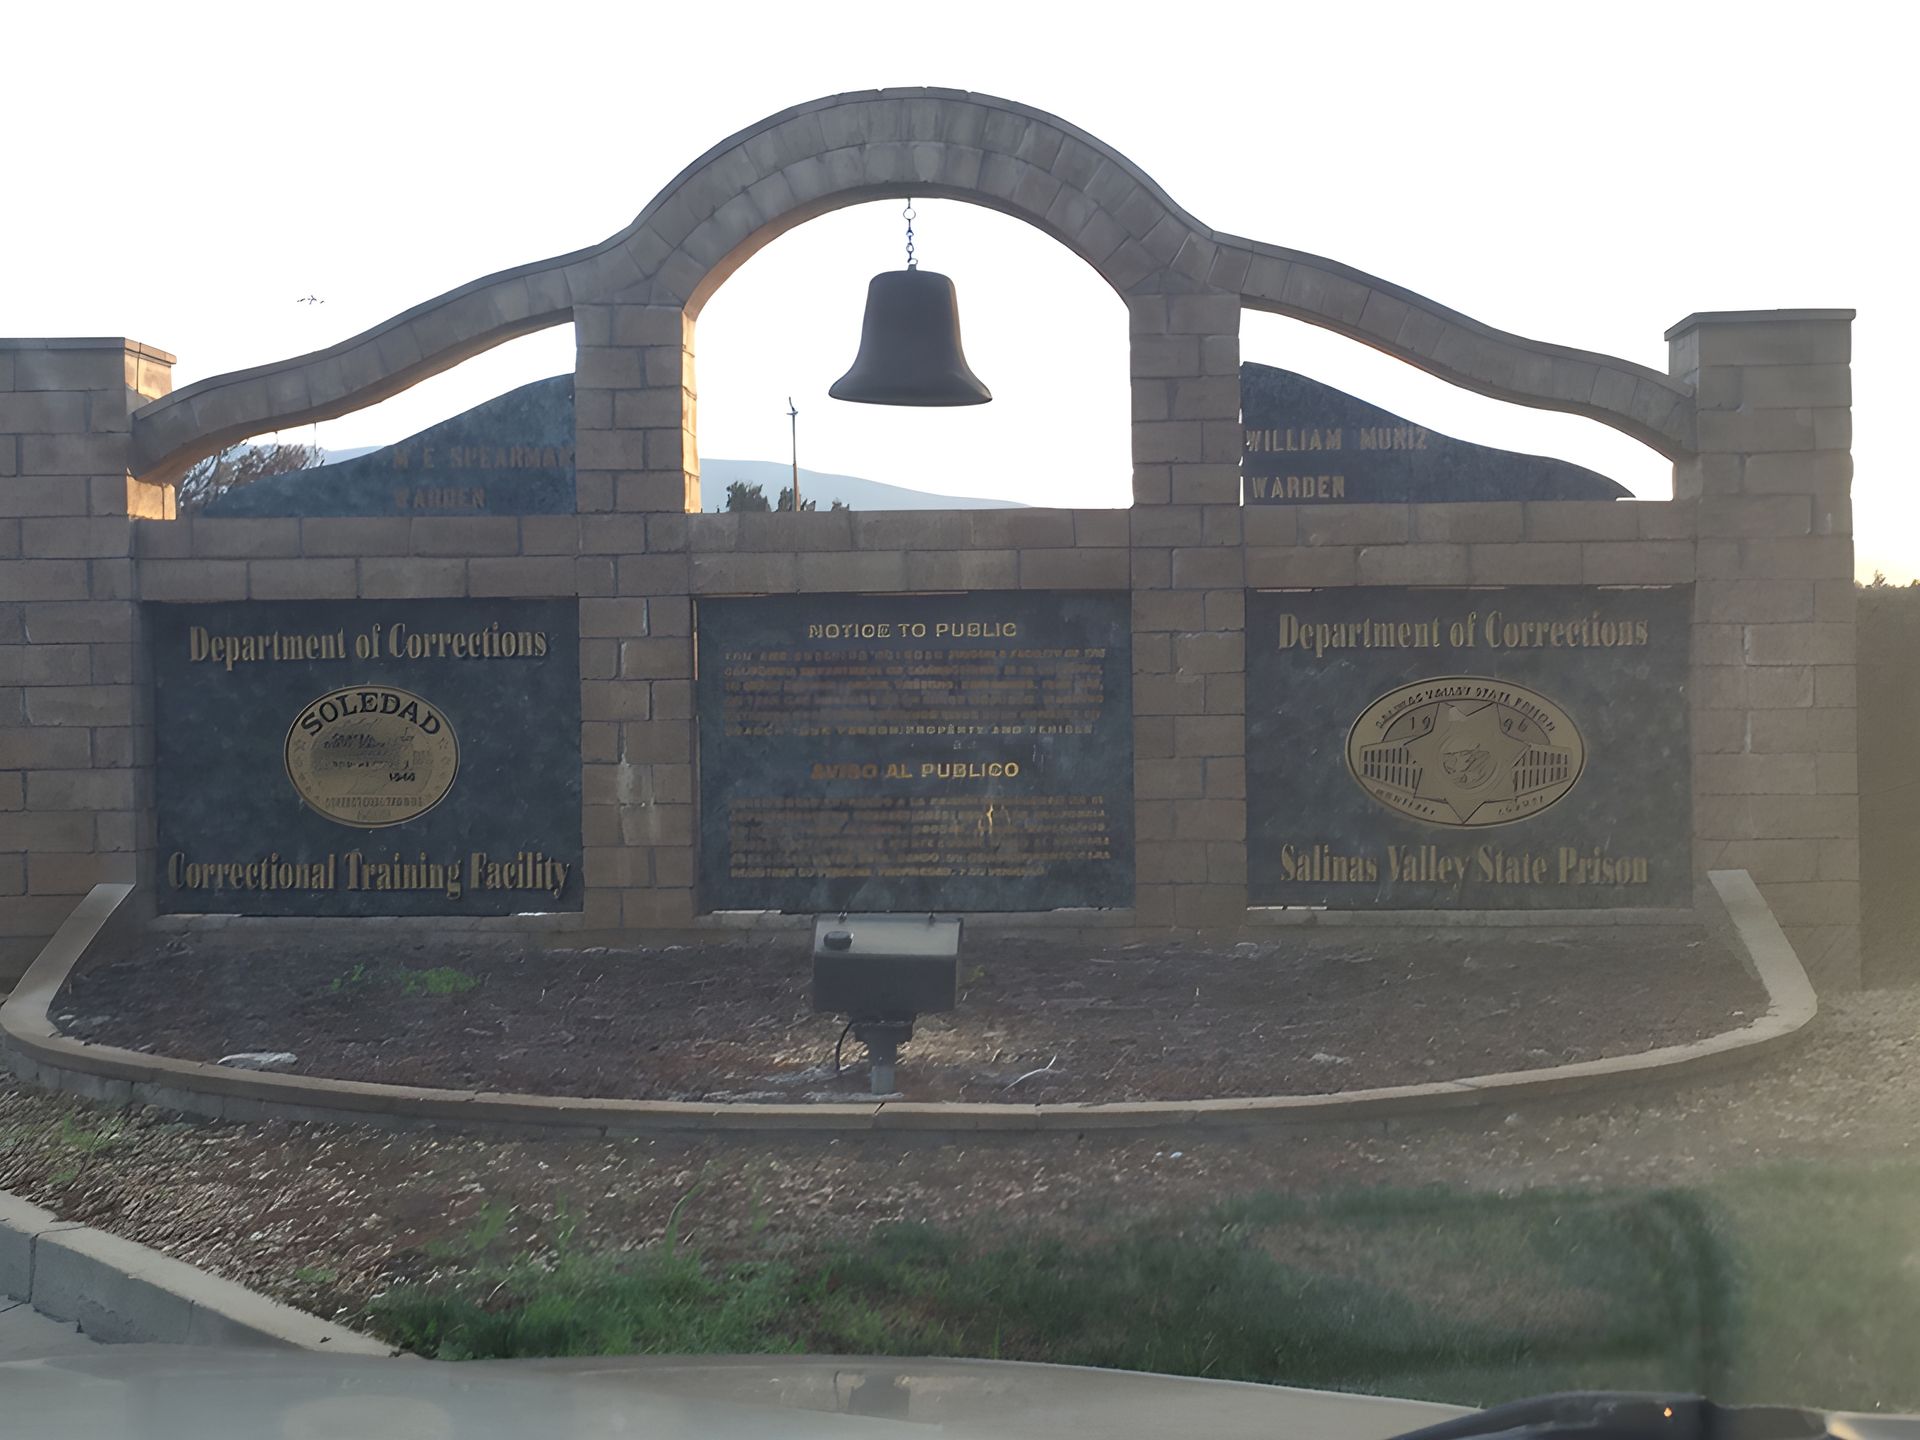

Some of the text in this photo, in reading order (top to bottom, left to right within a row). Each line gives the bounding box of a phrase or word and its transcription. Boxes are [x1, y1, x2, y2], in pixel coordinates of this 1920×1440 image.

[1246, 429, 1342, 452] WILLIAM
[422, 447, 435, 469] E
[1251, 475, 1345, 499] WARDEN
[190, 622, 548, 671] Department of Corrections
[808, 622, 1017, 639] NOTICE TO PUBLIC
[1278, 610, 1649, 658] Department of Corrections
[300, 691, 441, 737] SOLEDAD
[884, 763, 913, 779] AL
[921, 762, 1020, 779] PUBLICO
[168, 851, 570, 899] Correctional Training Facility
[1280, 843, 1649, 886] Salinas Valley State Prison
